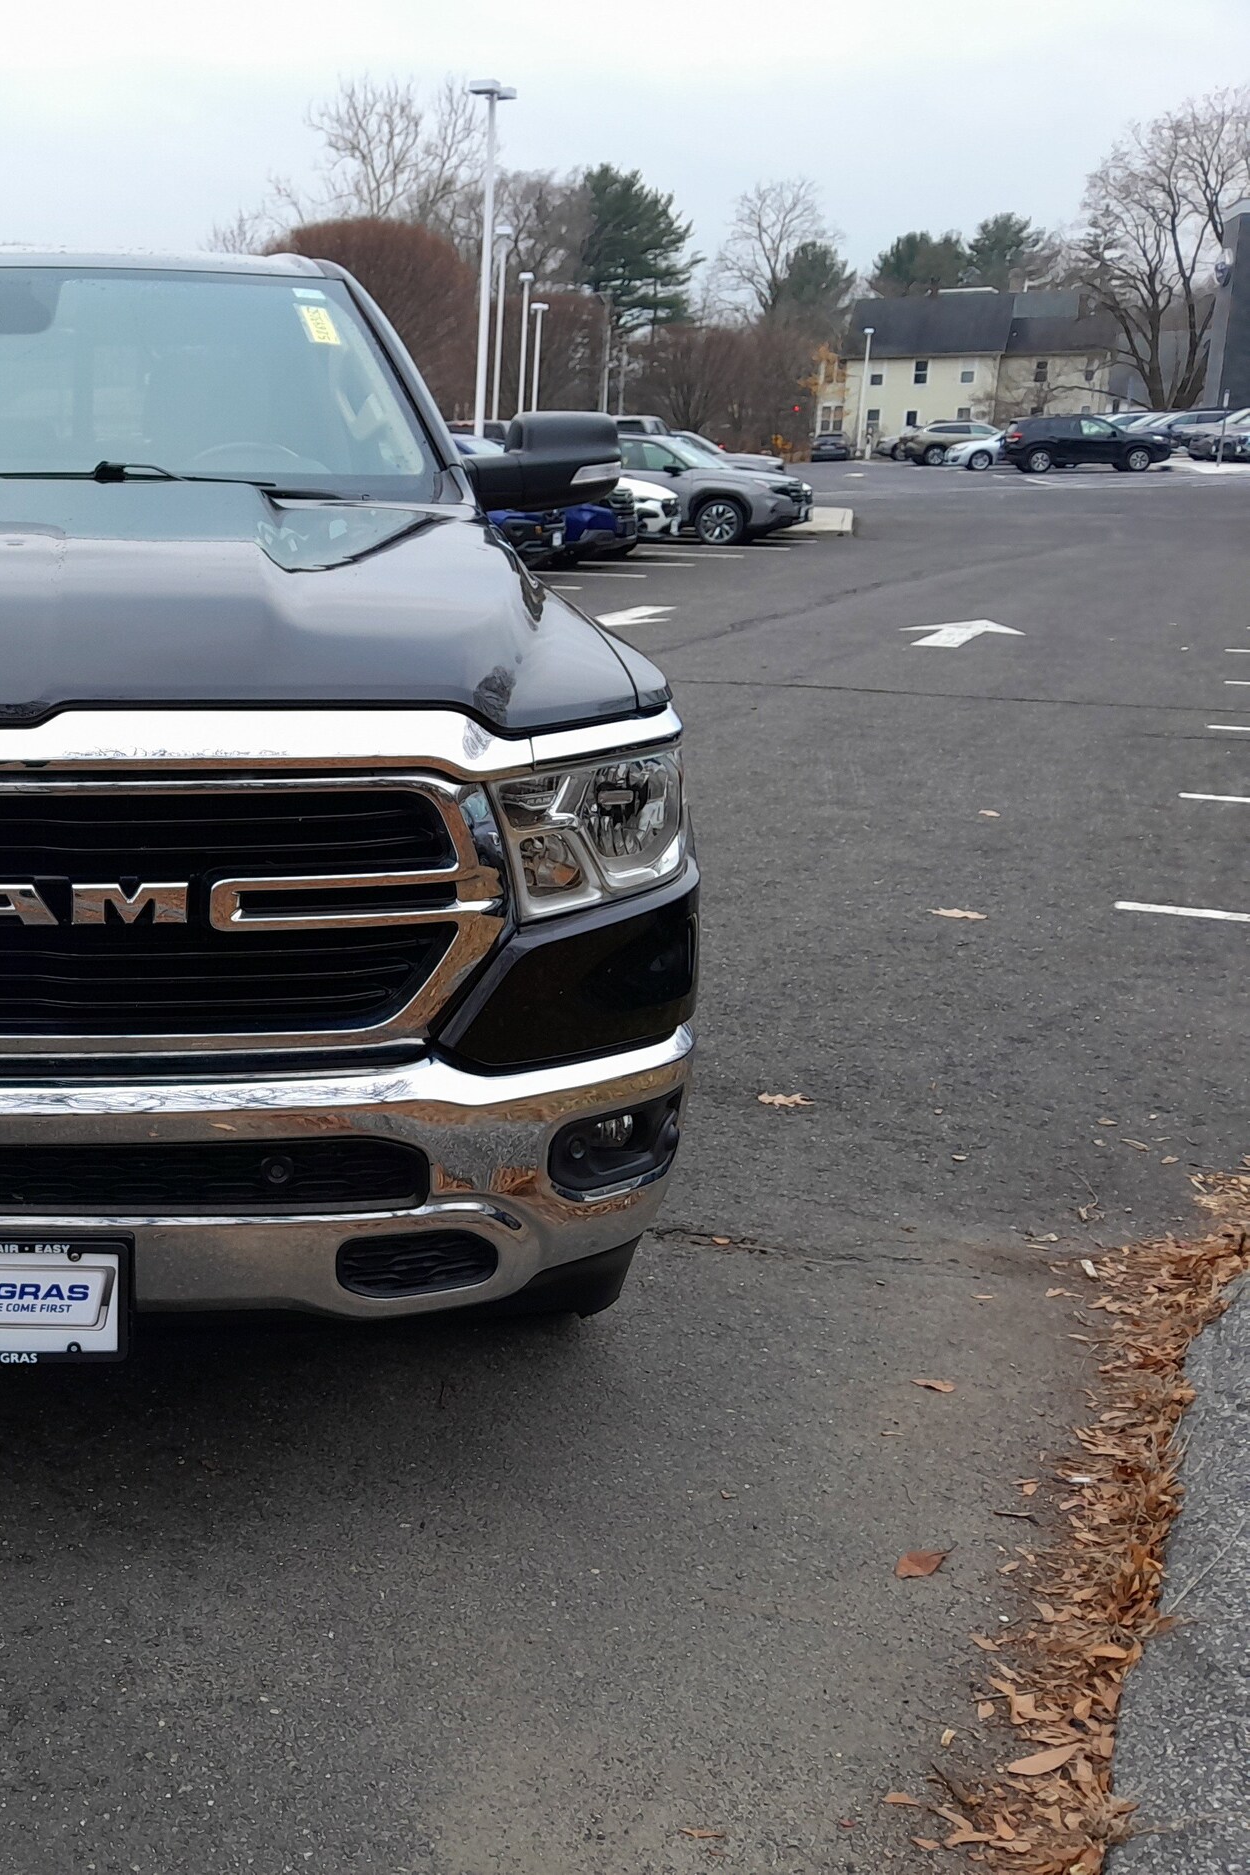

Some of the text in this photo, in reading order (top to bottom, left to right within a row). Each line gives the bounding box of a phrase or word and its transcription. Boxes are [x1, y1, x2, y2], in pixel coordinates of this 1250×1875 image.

[34, 1244, 70, 1254] EASY
[5, 1303, 37, 1313] COME
[39, 1304, 72, 1313] FIRST
